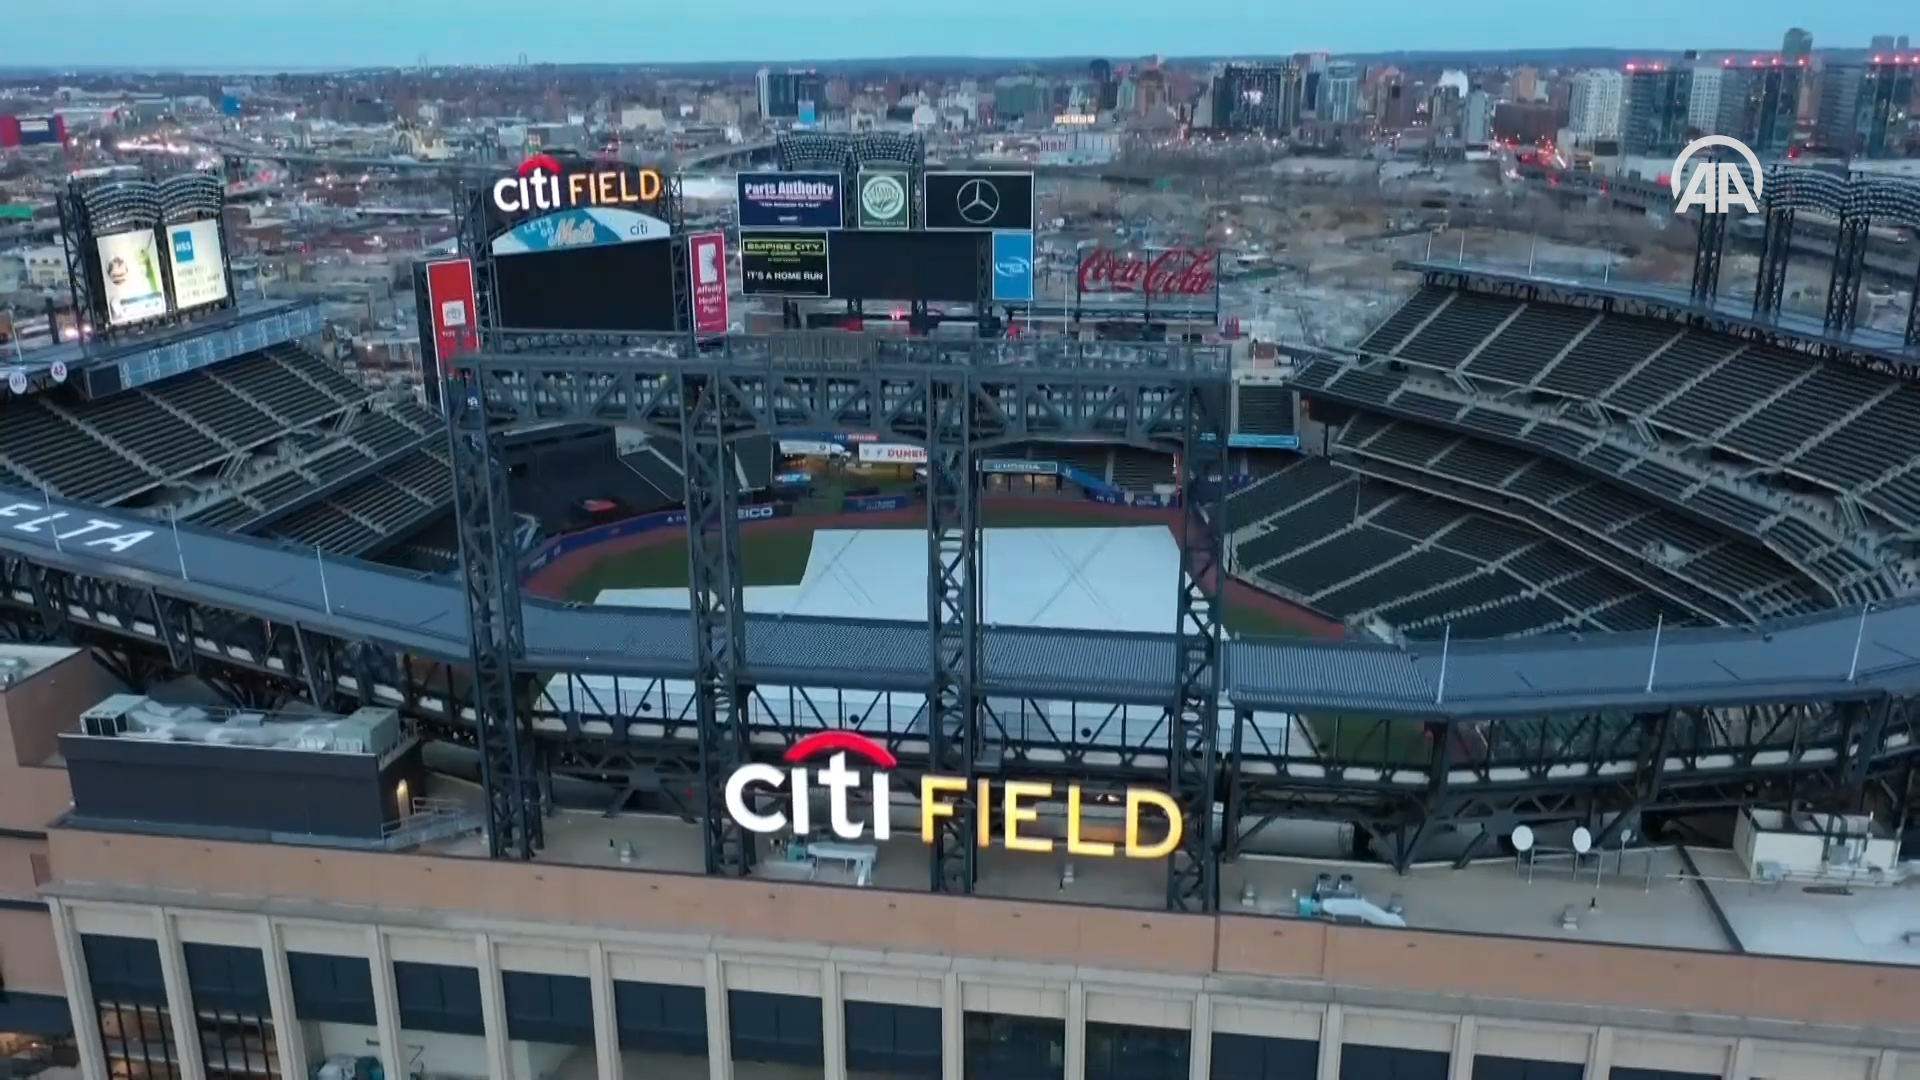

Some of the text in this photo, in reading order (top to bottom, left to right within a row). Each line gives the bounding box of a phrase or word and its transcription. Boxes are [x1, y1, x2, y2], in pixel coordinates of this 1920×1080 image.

[494, 163, 661, 211] citi FIELD
[745, 179, 834, 196] Parts Authority
[747, 243, 792, 251] EMPIRE
[747, 270, 823, 281] IT'S A HOME RUN
[737, 507, 773, 519] EICO
[725, 745, 1183, 858] citi FIELD
